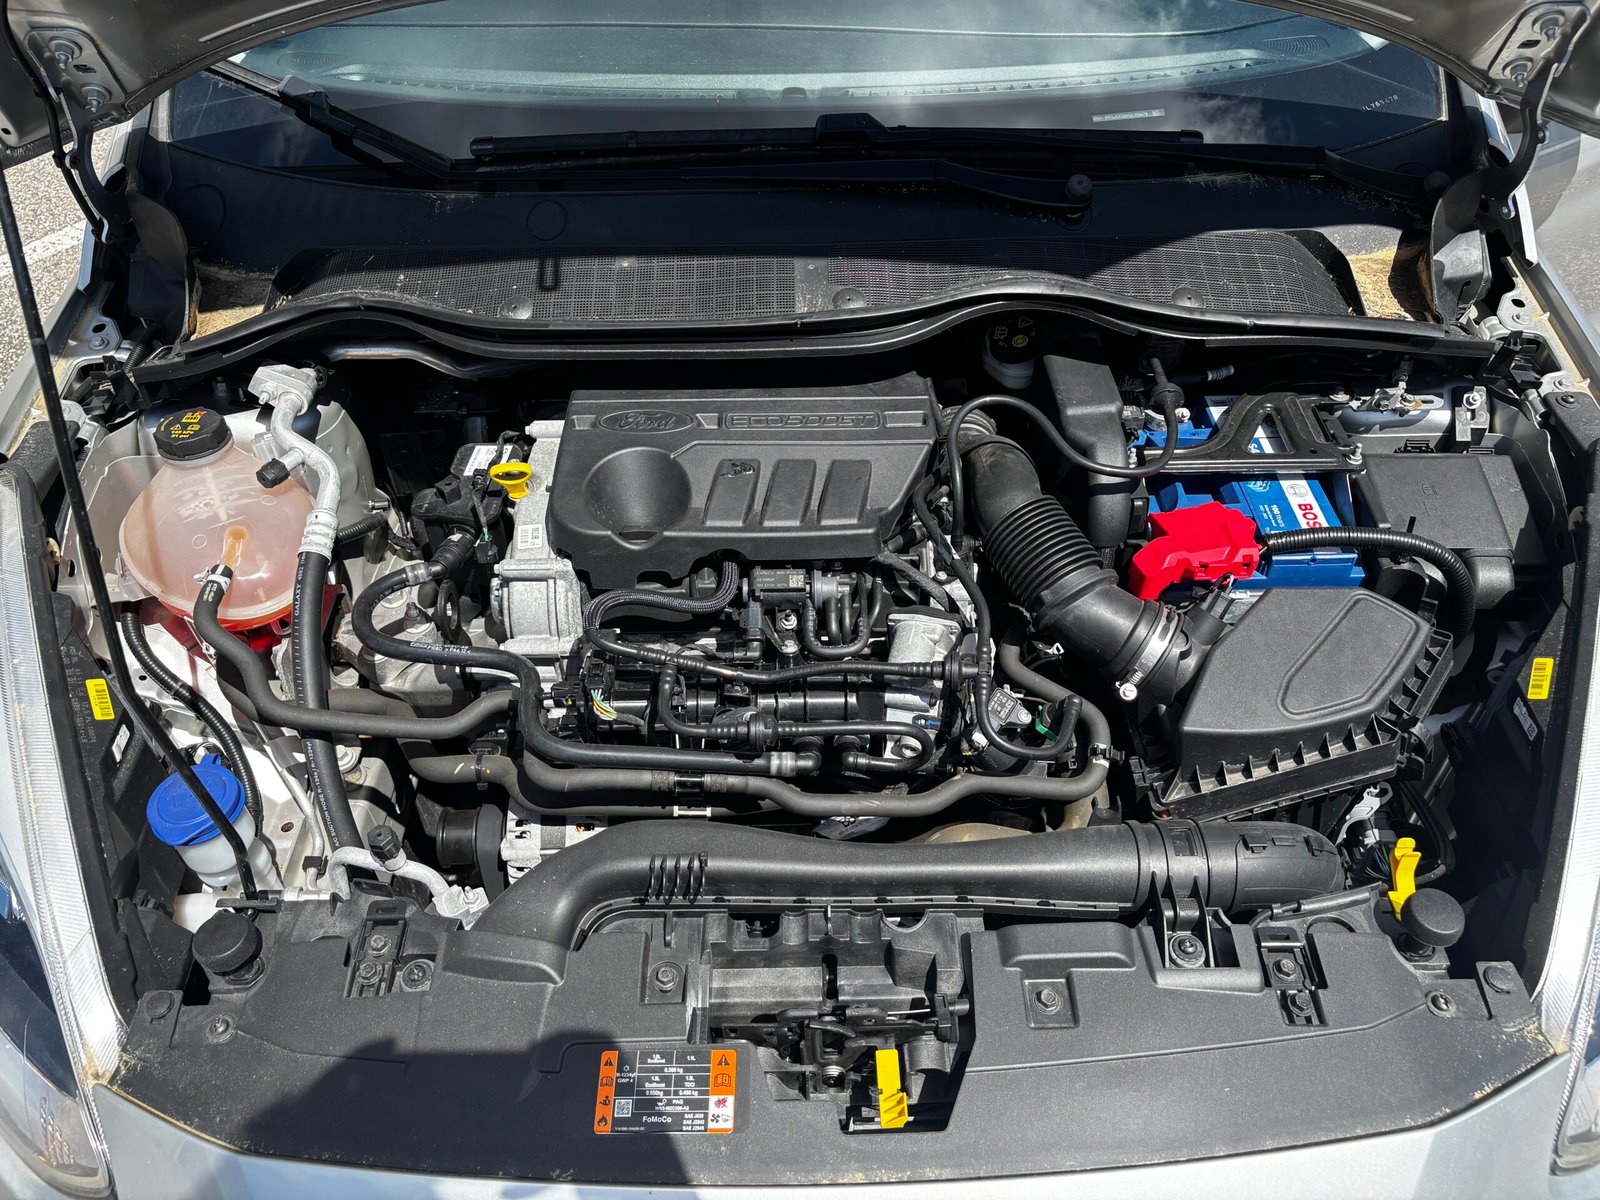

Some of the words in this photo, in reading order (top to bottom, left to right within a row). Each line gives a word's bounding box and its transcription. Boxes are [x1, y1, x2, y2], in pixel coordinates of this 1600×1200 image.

[616, 412, 676, 430] Ford
[1297, 503, 1323, 528] BOS
[294, 583, 302, 616] GALAXY
[319, 794, 328, 810] HOSE
[324, 810, 337, 837] SUCTION
[642, 1115, 672, 1123] FoMoCo
